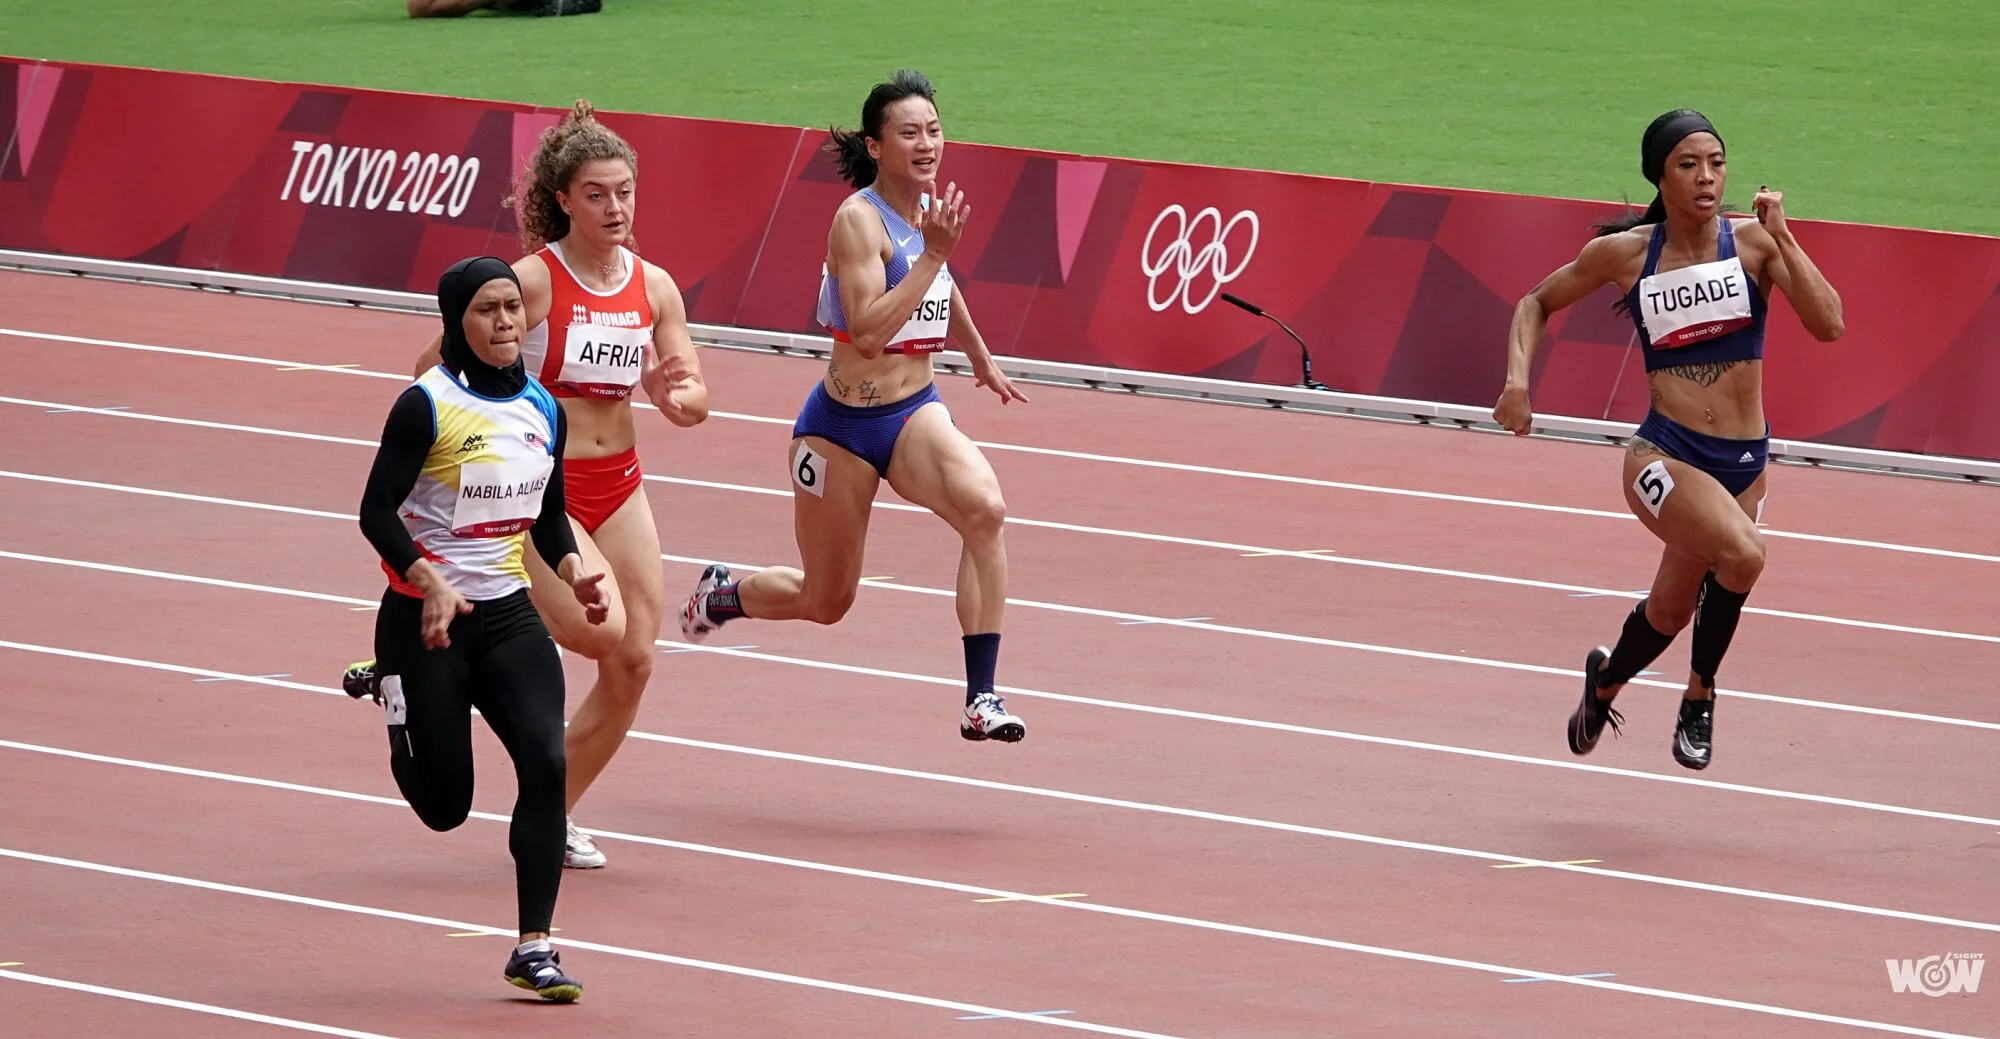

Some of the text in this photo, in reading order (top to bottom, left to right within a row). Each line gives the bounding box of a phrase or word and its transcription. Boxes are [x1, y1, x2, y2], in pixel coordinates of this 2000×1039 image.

[280, 140, 480, 218] TOKYO 2020
[1647, 275, 1740, 315] TUGADE
[589, 311, 642, 327] MONACO
[909, 299, 949, 321] HSIE
[1678, 332, 1695, 340] TOKYO
[798, 451, 816, 487] 6
[462, 477, 546, 499] NABILA ALIAS
[1639, 469, 1664, 506] 5
